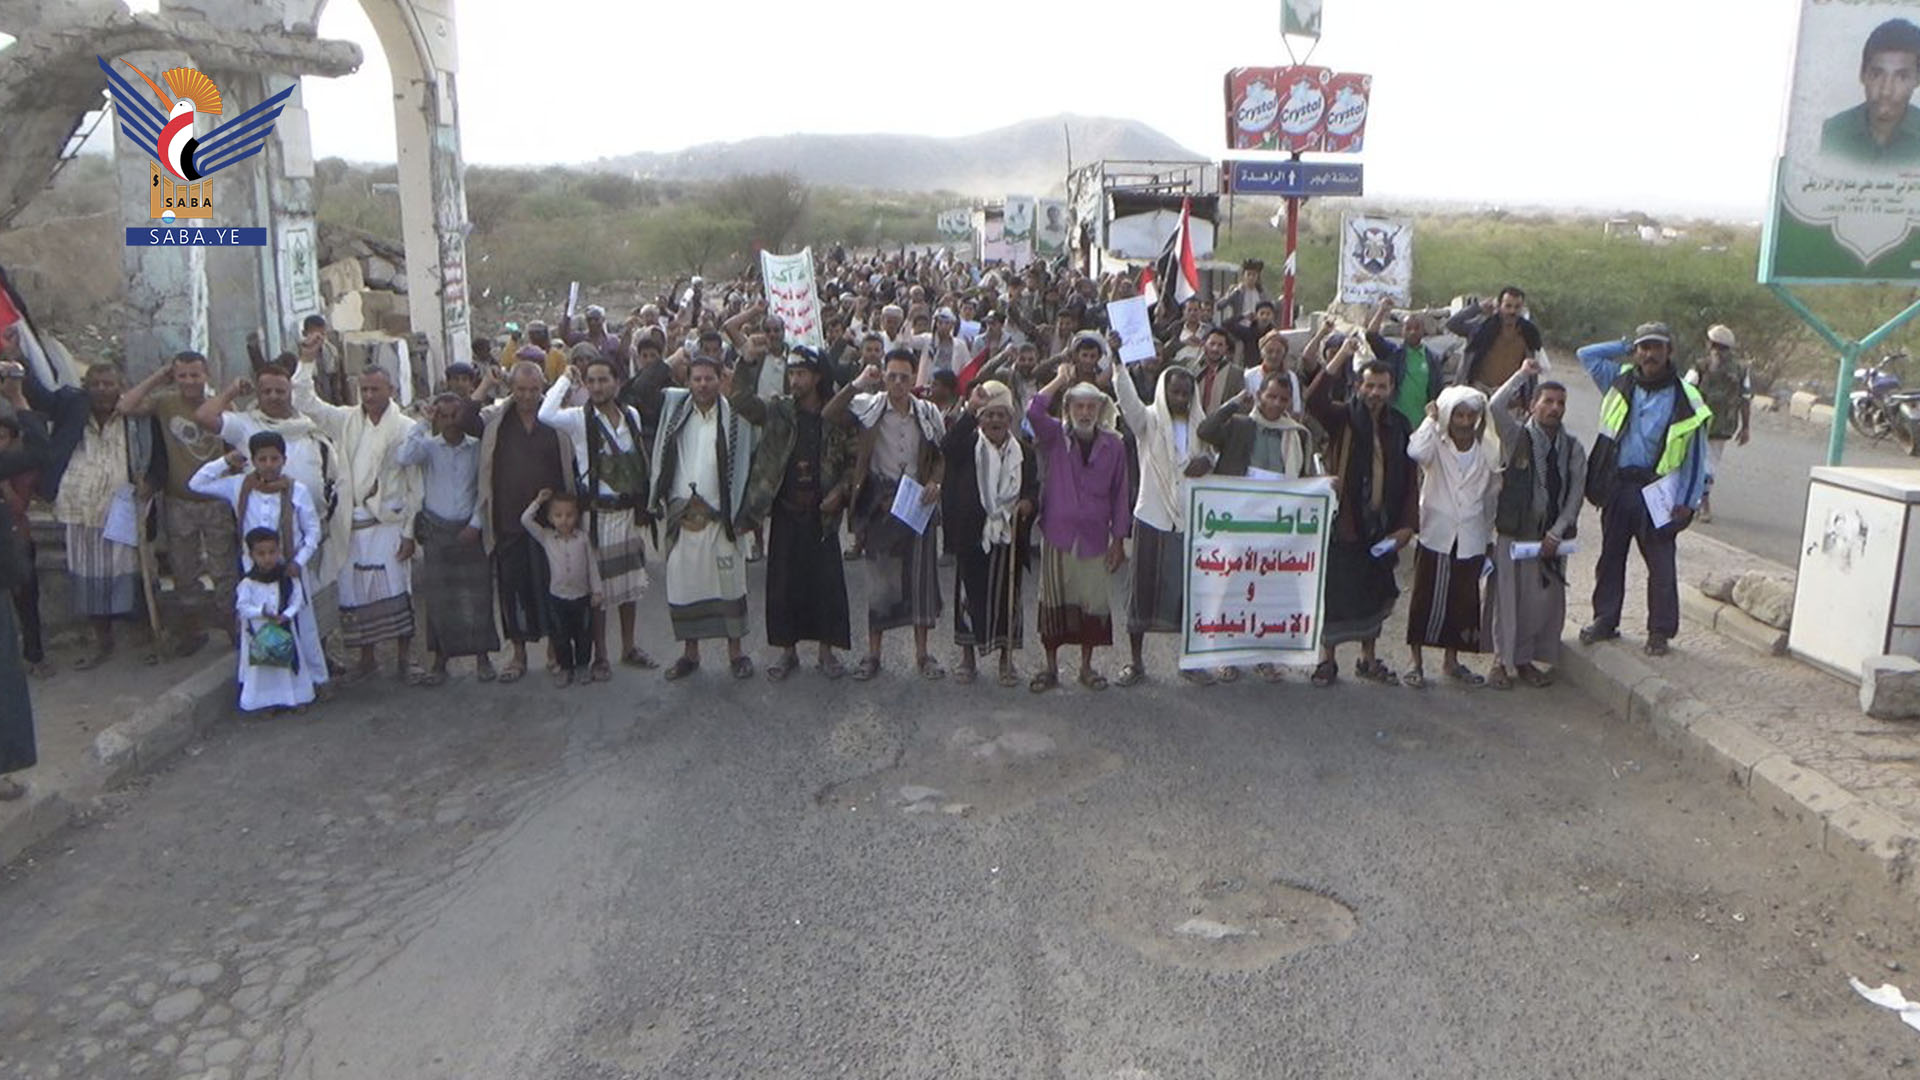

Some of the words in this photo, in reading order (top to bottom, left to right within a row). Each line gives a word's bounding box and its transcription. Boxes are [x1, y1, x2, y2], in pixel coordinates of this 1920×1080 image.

[1236, 98, 1278, 122] Crystal
[1280, 96, 1322, 124] Crystal
[1327, 101, 1365, 125] Crystal
[1198, 502, 1320, 539] قاطعوا
[1195, 546, 1258, 577] الأمريكية
[1260, 549, 1316, 577] البضائع
[1246, 581, 1256, 602] و
[1194, 611, 1311, 639] الإسرائيلية
